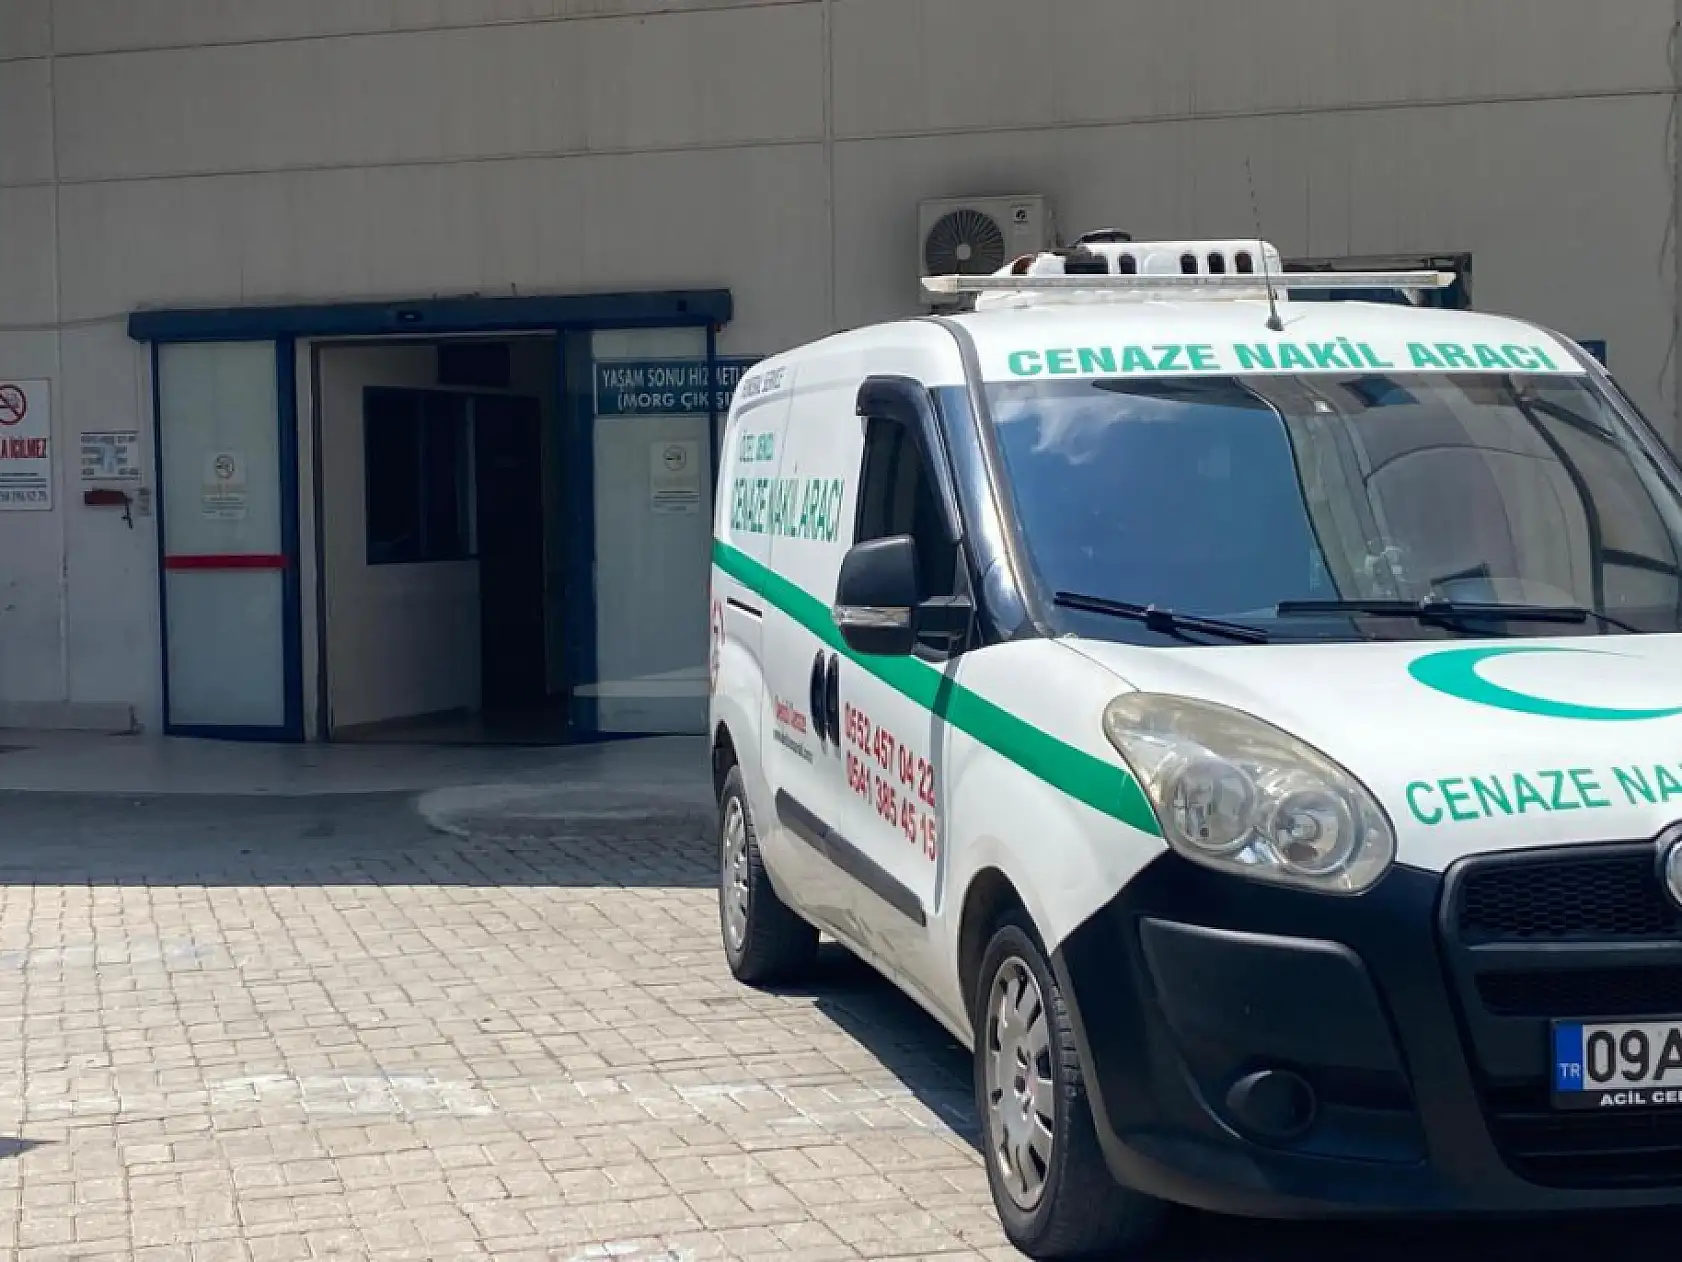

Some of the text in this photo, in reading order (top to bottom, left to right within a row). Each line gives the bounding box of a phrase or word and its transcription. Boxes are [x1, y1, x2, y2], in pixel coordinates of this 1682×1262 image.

[1008, 336, 1560, 375] CENAZE NAKİL ARACI
[602, 366, 645, 392] YAŞAM
[647, 366, 686, 388] SONU
[617, 392, 675, 411] (MORG
[873, 724, 895, 776] 457
[898, 743, 914, 792] 04
[916, 756, 936, 808] 22
[1405, 763, 1682, 825] CENAZE NA
[898, 796, 916, 846] 45
[918, 812, 936, 862] 15
[1559, 1063, 1581, 1078] TR
[1599, 1090, 1647, 1107] ACİL
